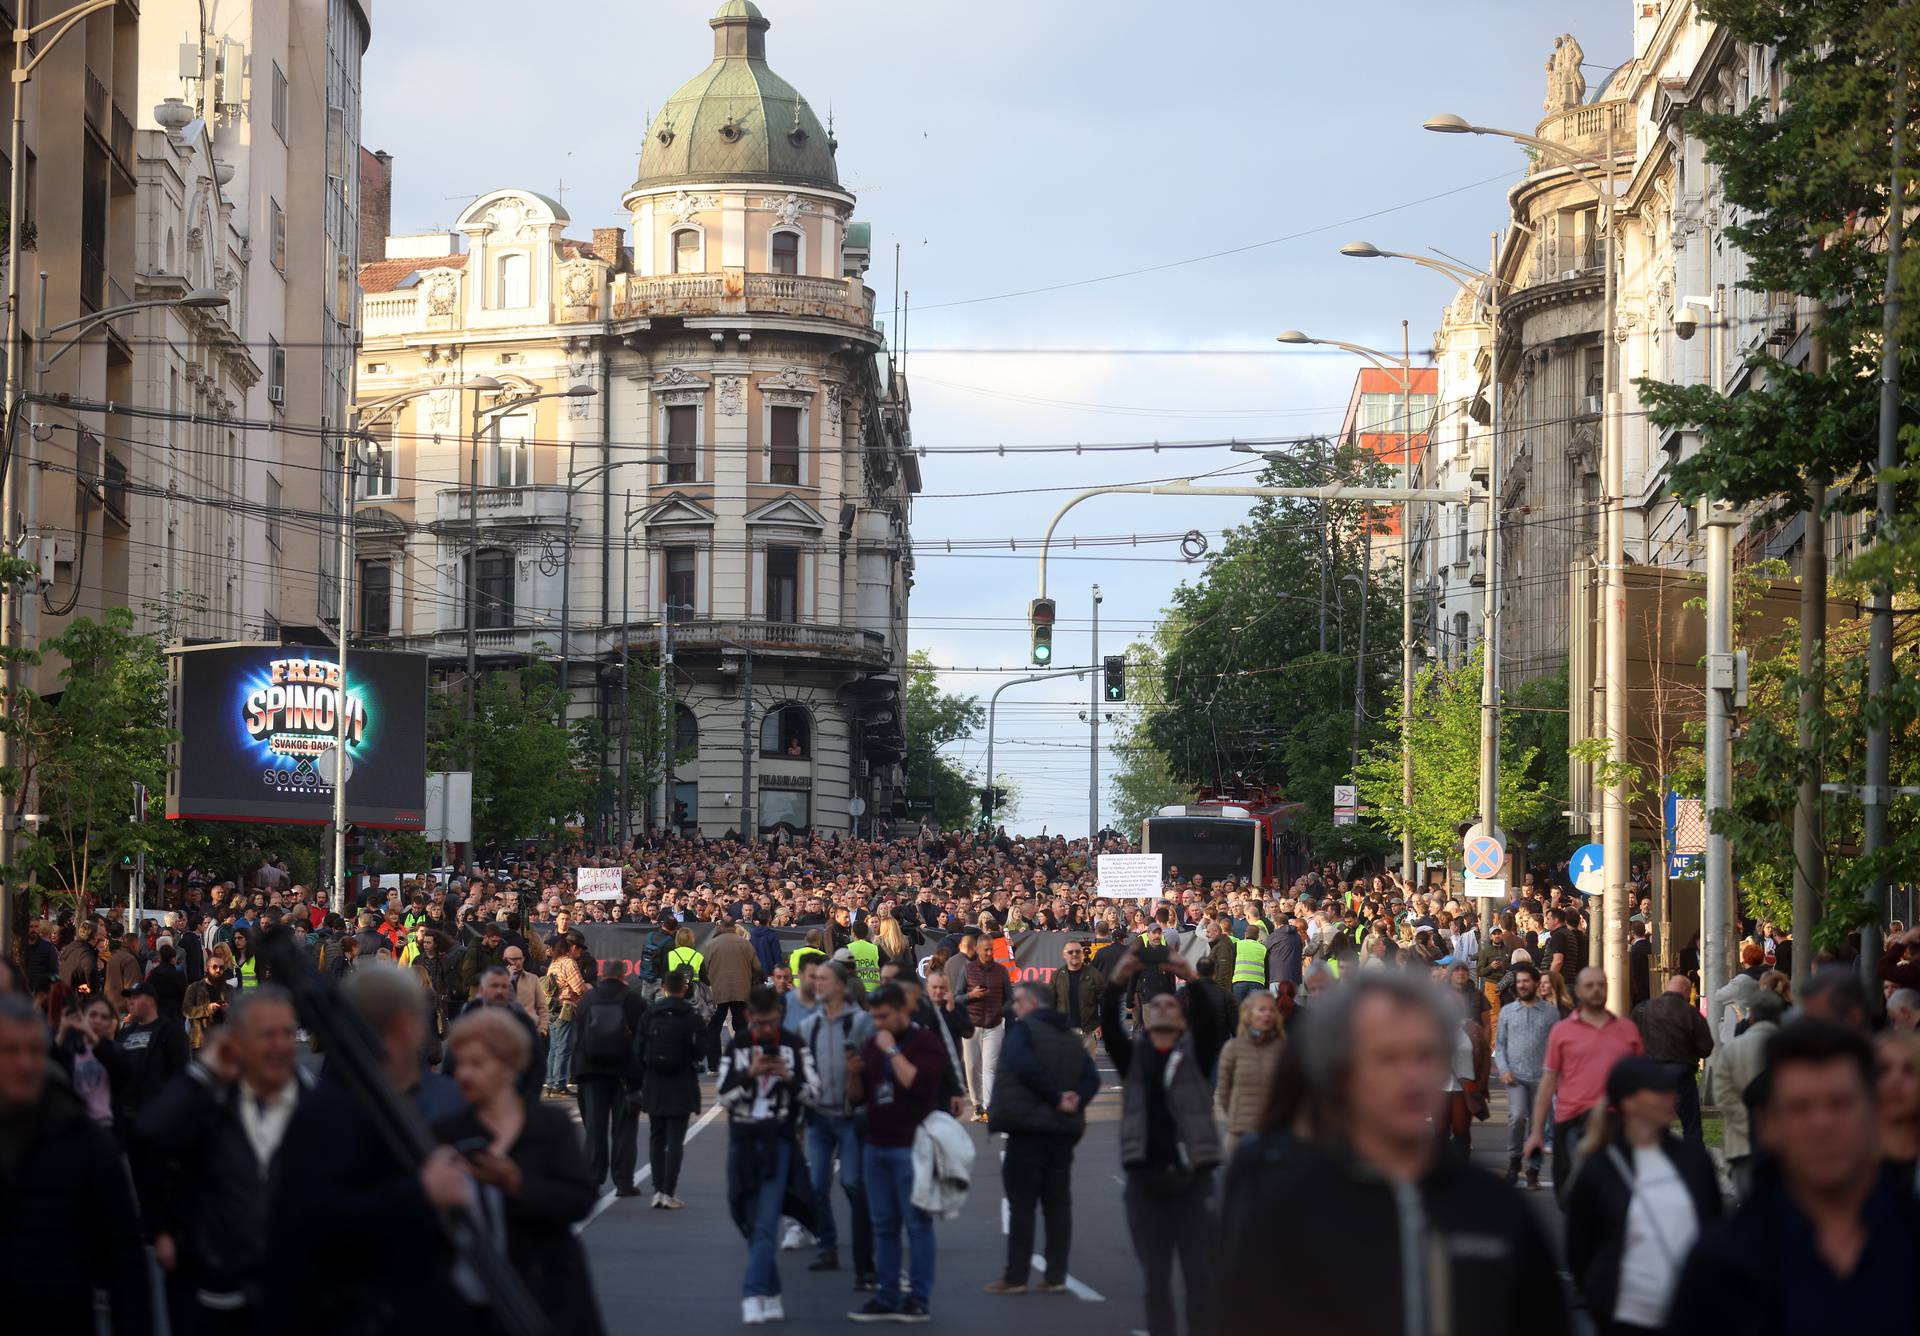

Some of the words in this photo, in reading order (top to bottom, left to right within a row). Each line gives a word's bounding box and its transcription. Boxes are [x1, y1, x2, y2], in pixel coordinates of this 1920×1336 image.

[270, 659, 340, 688] FREE
[247, 685, 363, 743] SPINOVI
[274, 739, 309, 750] SVAKOG
[276, 786, 331, 794] GAMBLING
